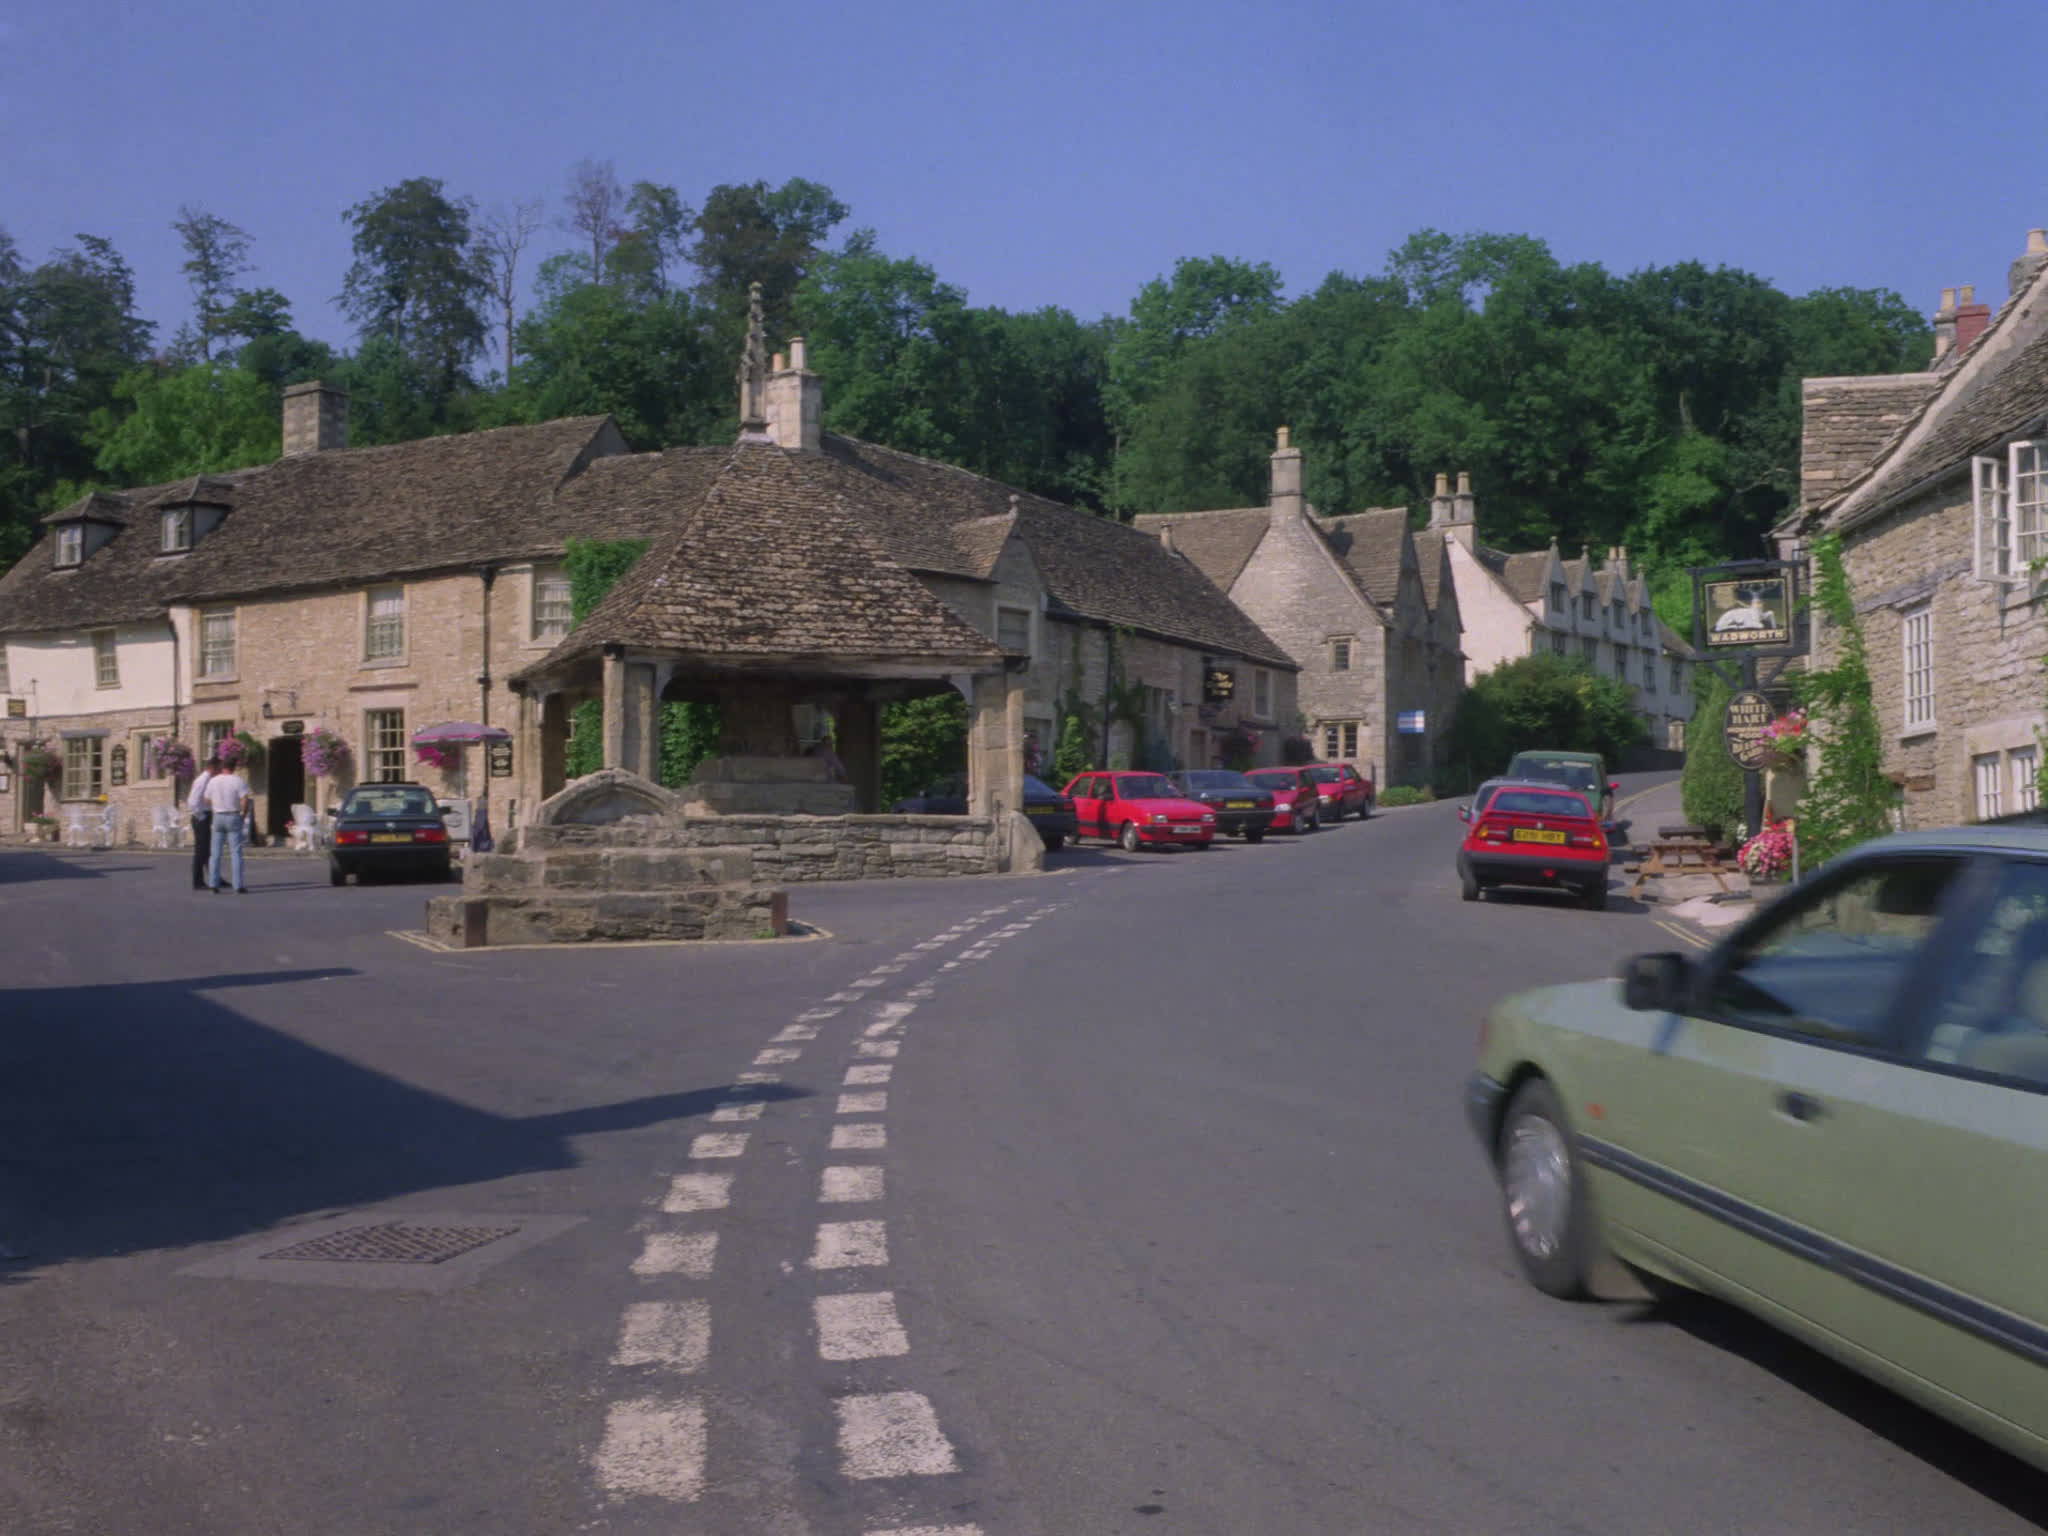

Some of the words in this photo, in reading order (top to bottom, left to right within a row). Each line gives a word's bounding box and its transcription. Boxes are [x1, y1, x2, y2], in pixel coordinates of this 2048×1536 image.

[1711, 629, 1785, 643] WADWORTH
[1729, 704, 1768, 714] WHITE
[1732, 714, 1766, 724] HART
